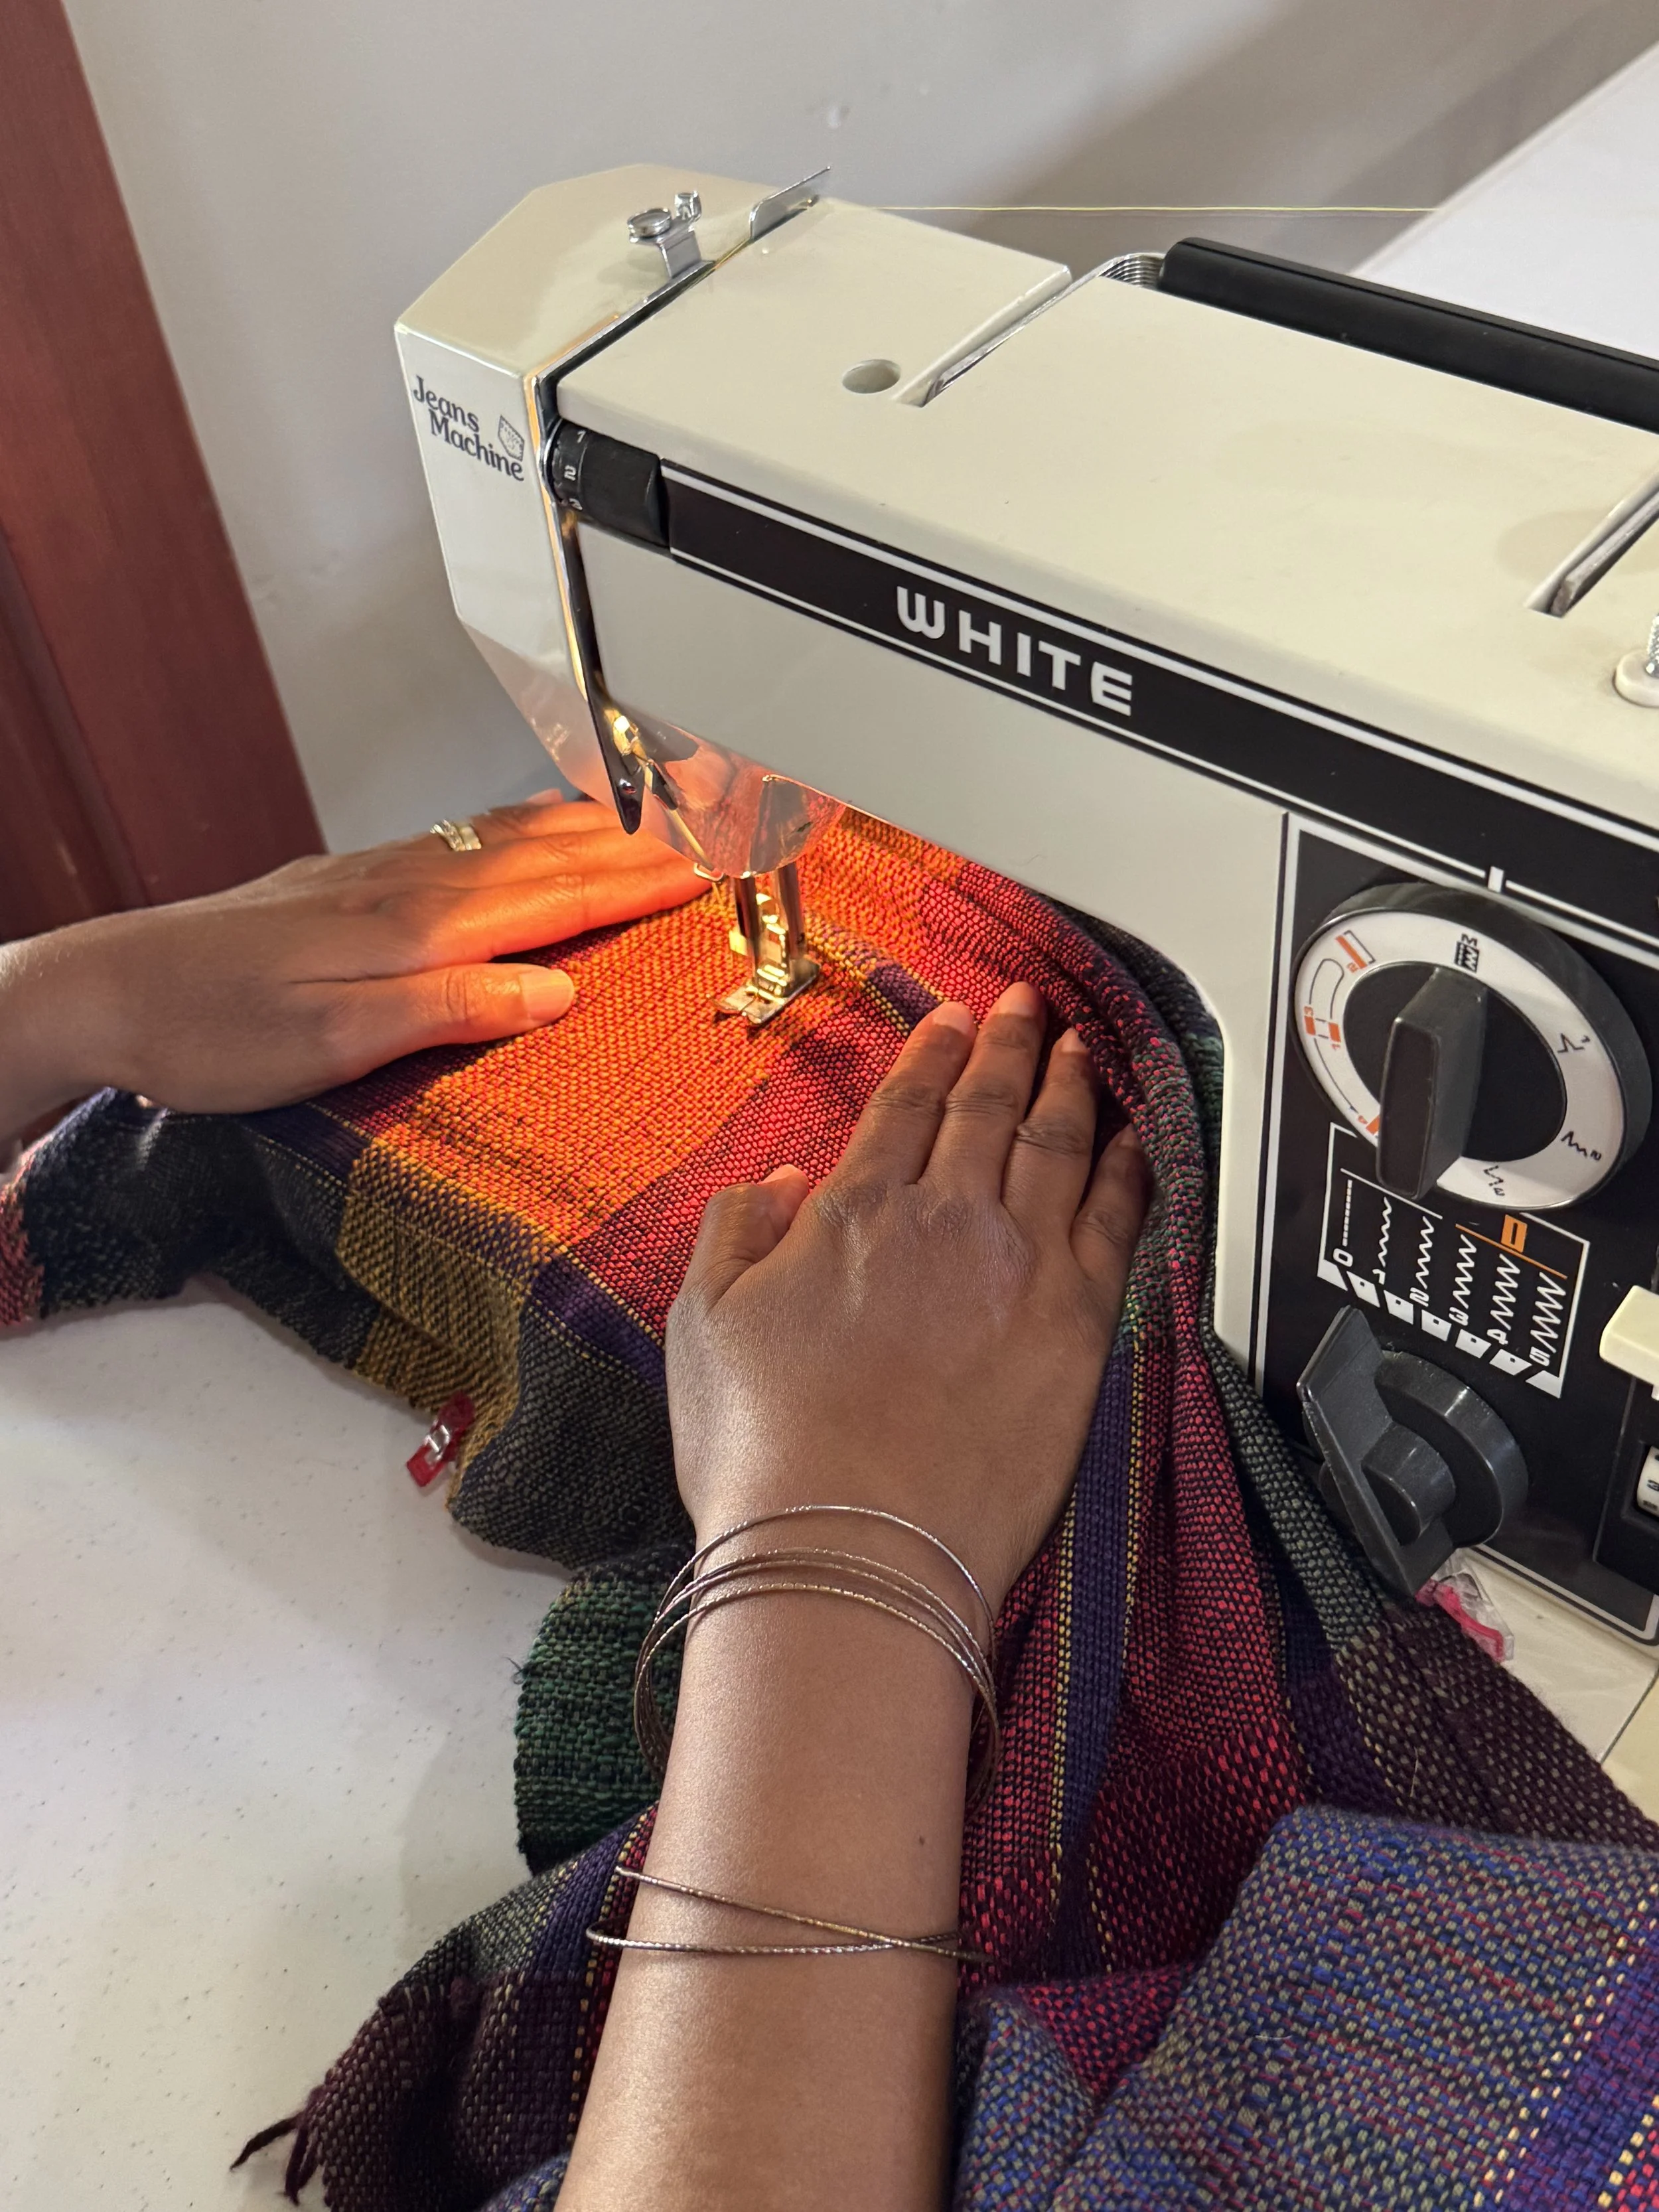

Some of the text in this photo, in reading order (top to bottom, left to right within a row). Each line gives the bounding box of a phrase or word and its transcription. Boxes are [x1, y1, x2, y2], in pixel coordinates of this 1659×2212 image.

[413, 374, 479, 432] Jeans
[429, 408, 524, 481] Machine
[577, 430, 587, 443] 1
[564, 465, 576, 481] 2
[897, 585, 1133, 717] WHITE
[1333, 1248, 1550, 1366] 0 1 2 3 4 5
